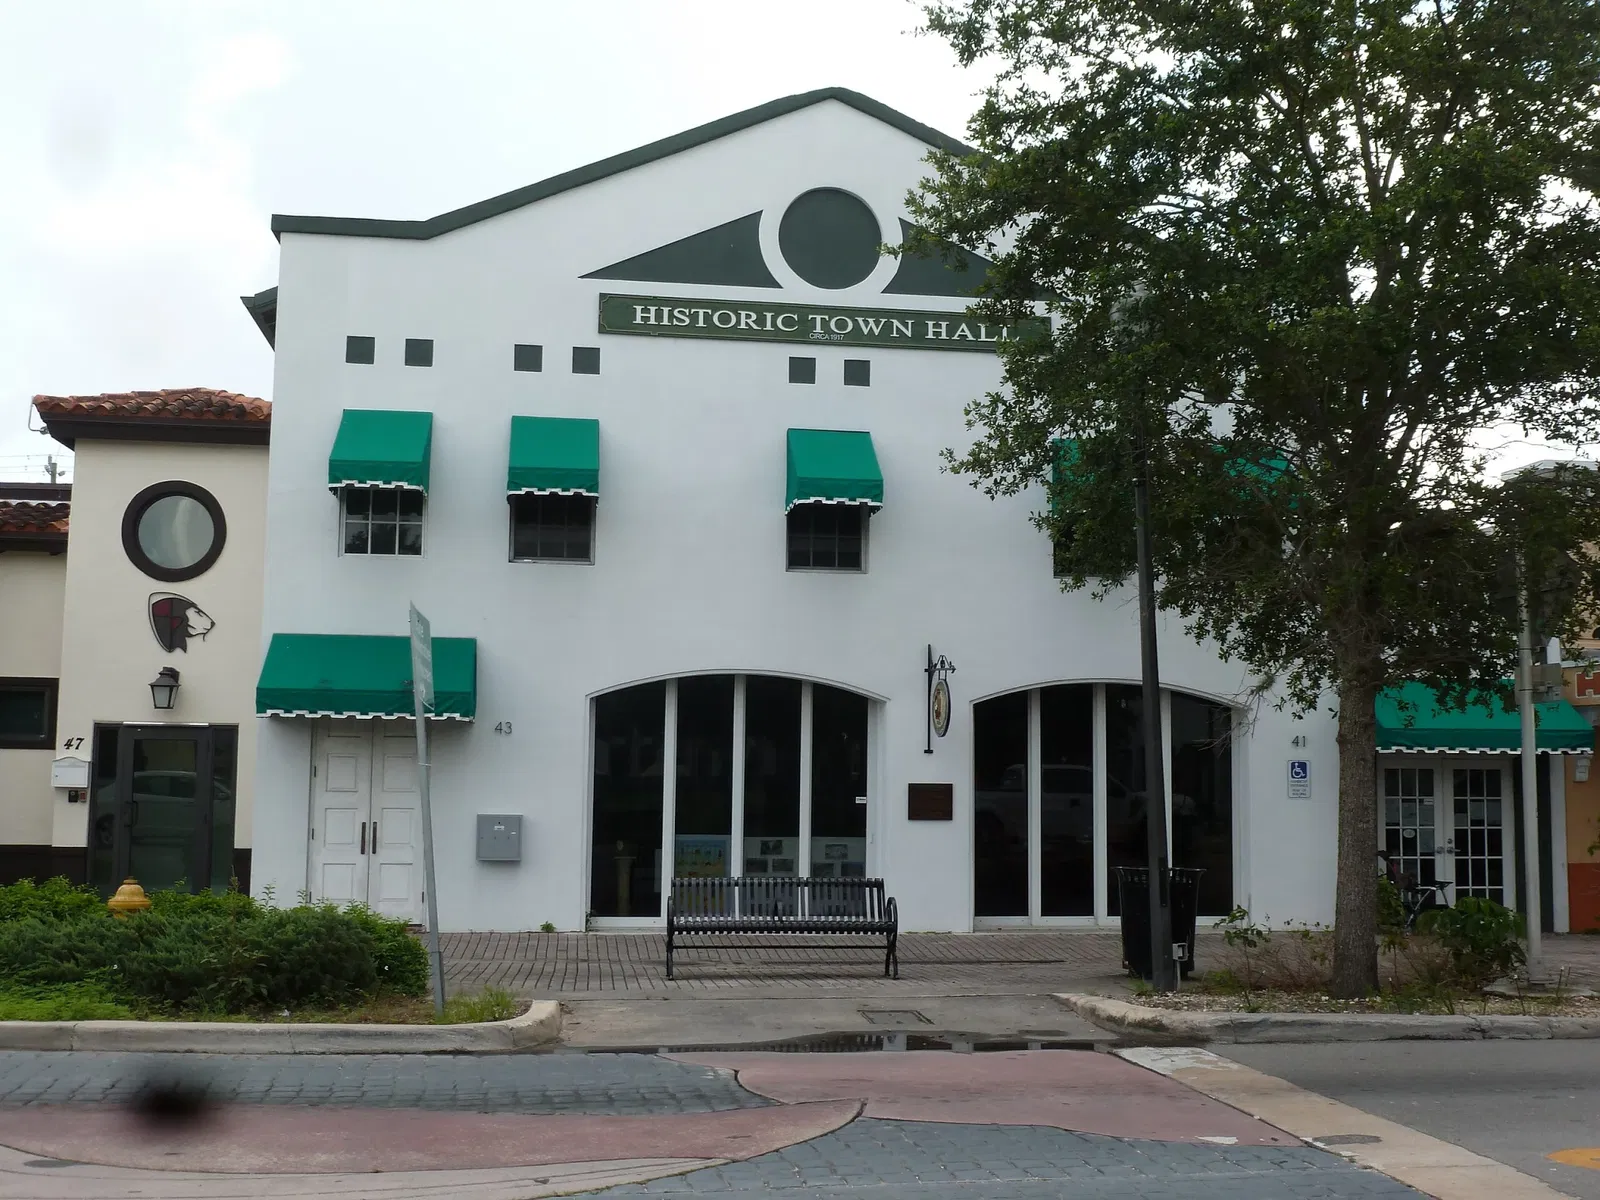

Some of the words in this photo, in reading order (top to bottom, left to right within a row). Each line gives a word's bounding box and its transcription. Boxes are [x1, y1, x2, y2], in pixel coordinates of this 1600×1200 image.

[632, 305, 799, 332] HISTORIC
[808, 314, 915, 338] TOWN
[809, 332, 830, 340] CIRCA
[494, 721, 513, 735] 43
[63, 737, 85, 750] 47
[1291, 735, 1306, 747] 41
